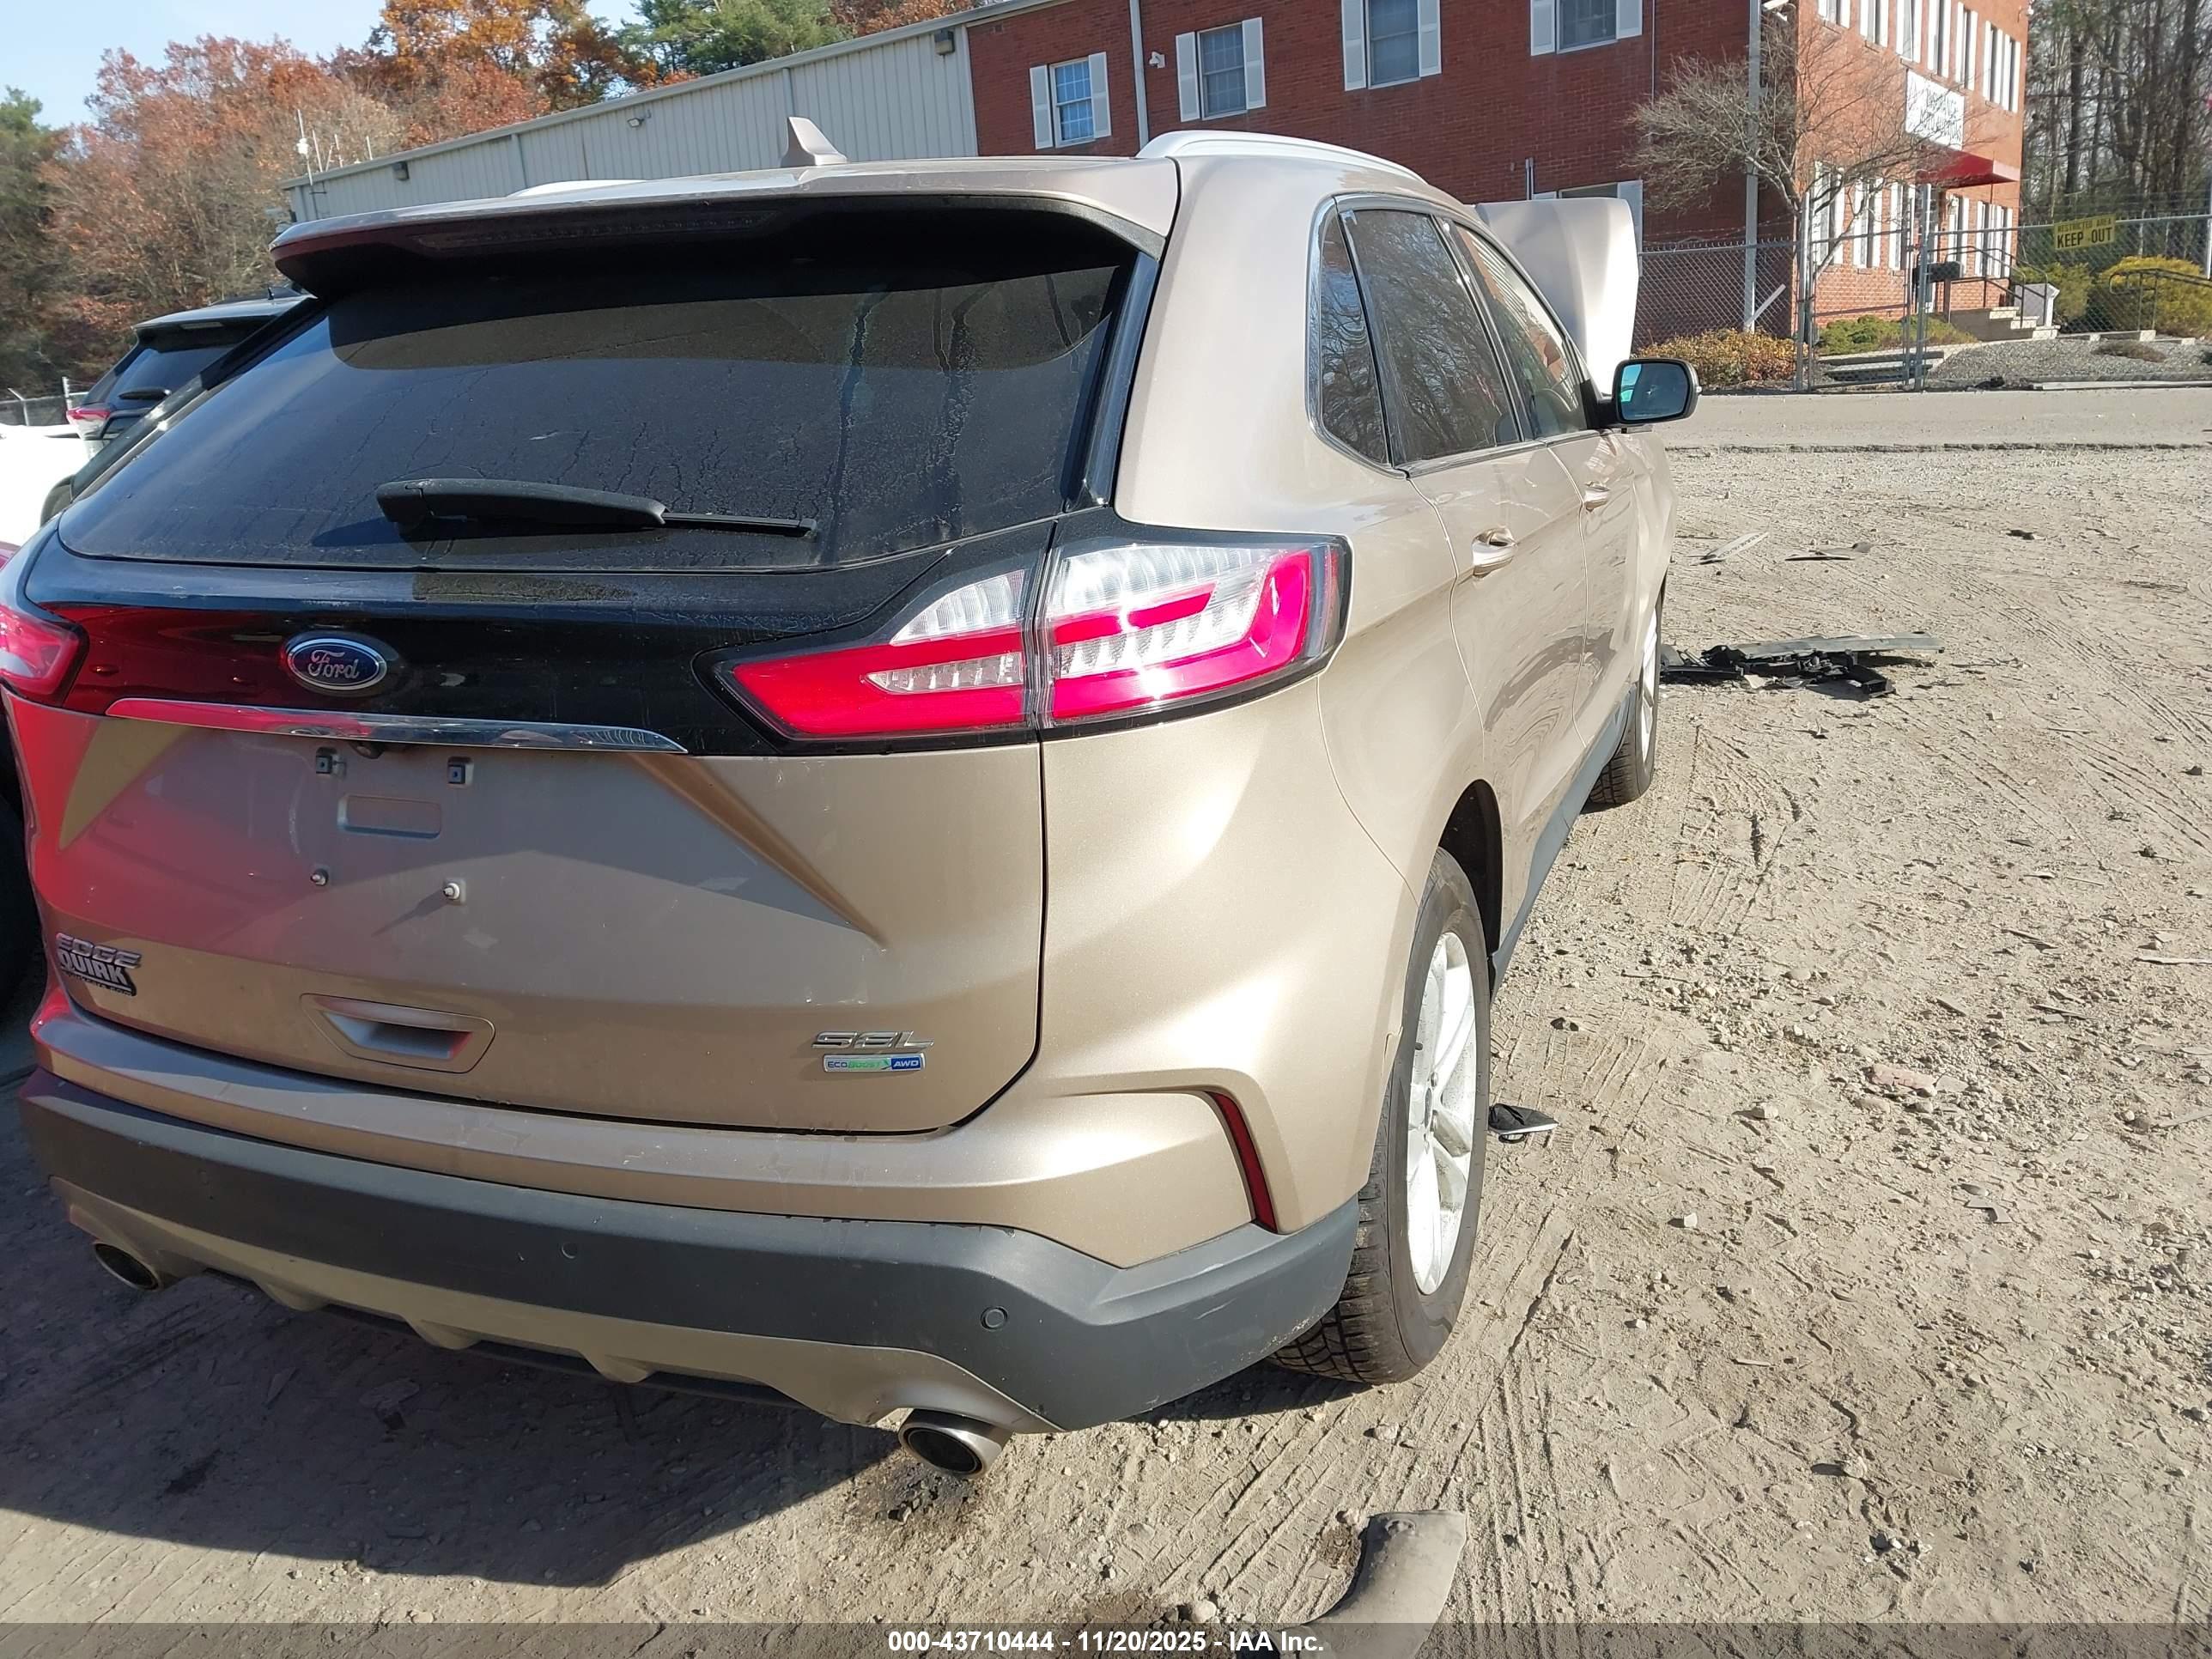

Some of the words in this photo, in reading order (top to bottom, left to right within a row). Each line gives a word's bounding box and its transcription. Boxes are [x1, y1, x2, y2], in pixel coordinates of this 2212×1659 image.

[2057, 231, 2083, 248] KEEP
[2091, 228, 2112, 243] OUT
[307, 649, 360, 679] Ford
[56, 933, 142, 969] EDGE
[57, 950, 128, 986] QUIRK
[811, 1030, 934, 1049] SEL
[892, 1060, 920, 1068] AWD
